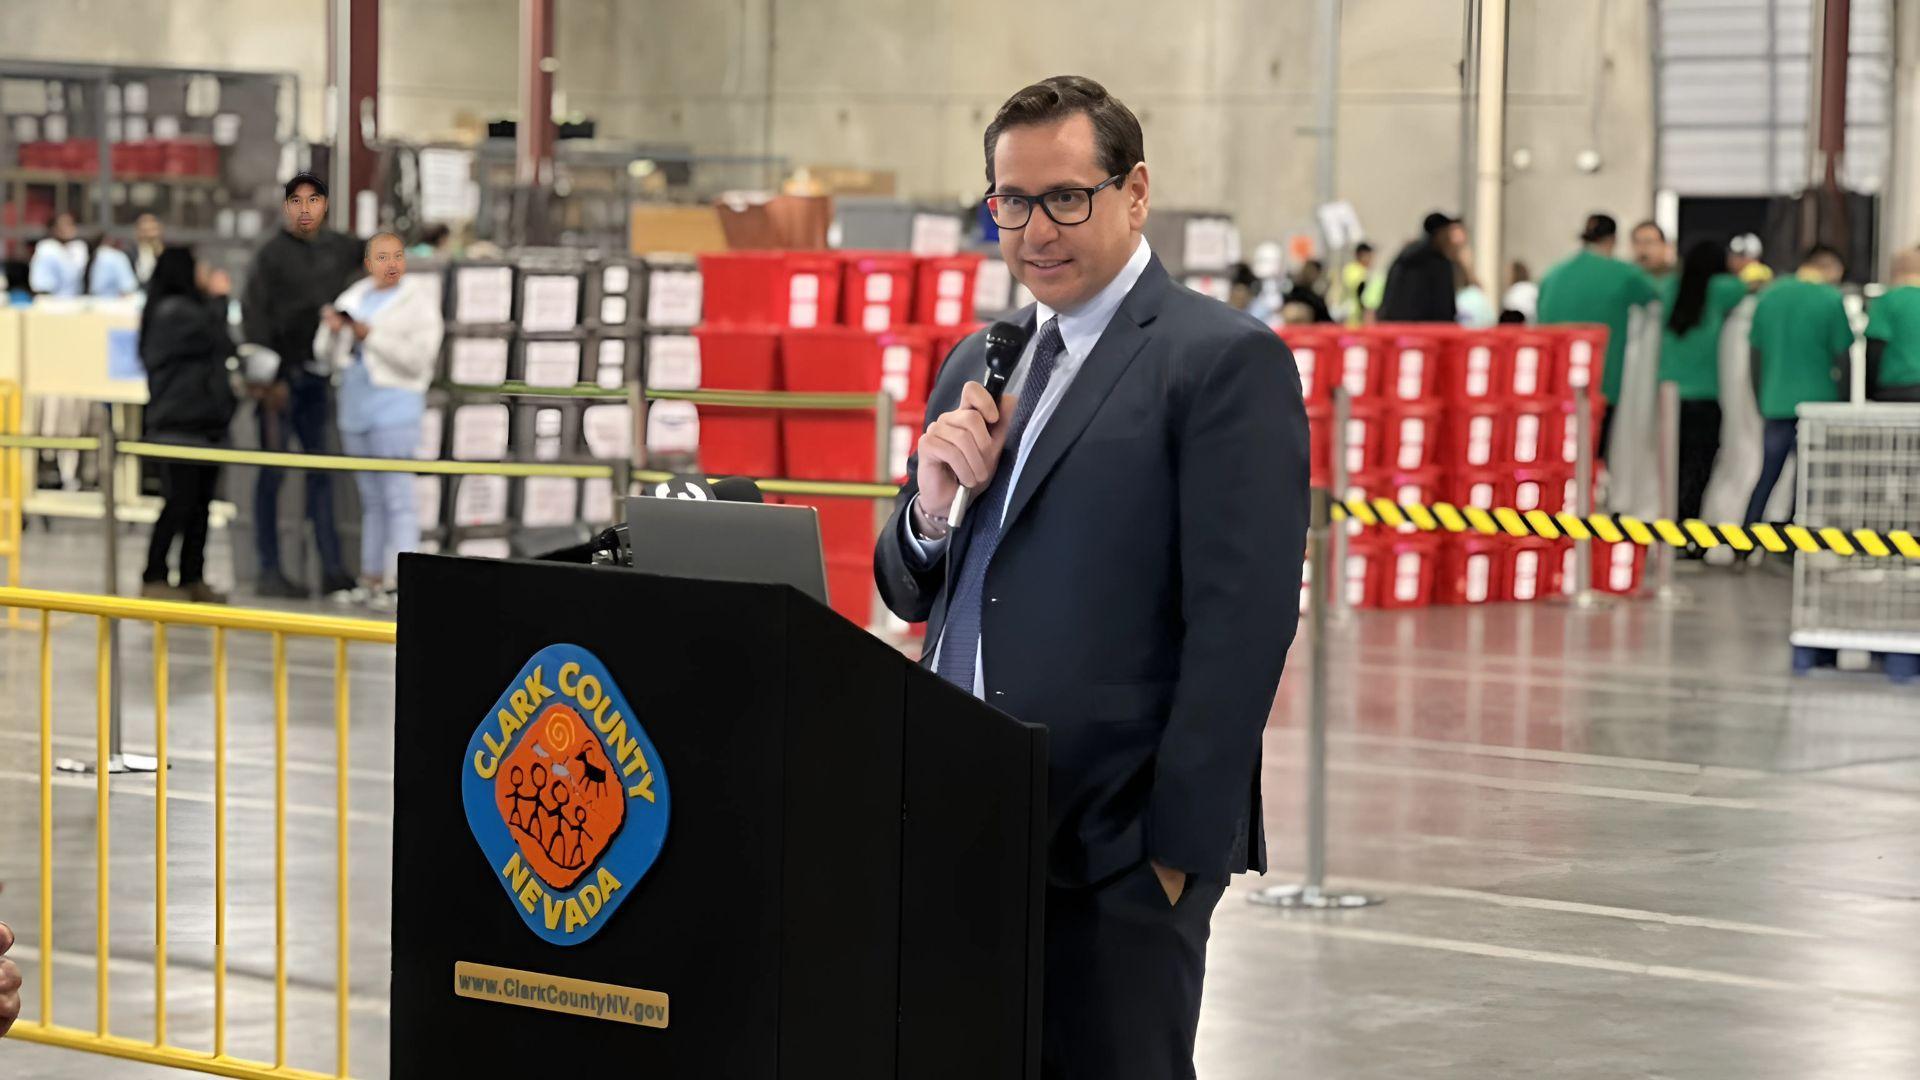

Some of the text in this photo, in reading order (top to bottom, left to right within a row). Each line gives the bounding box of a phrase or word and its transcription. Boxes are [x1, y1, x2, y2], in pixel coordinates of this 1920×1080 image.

[474, 662, 655, 804] CLARK COUNTY
[502, 852, 622, 933] NEVADA
[458, 973, 665, 1022] www.ClarkCountyNV.gov
